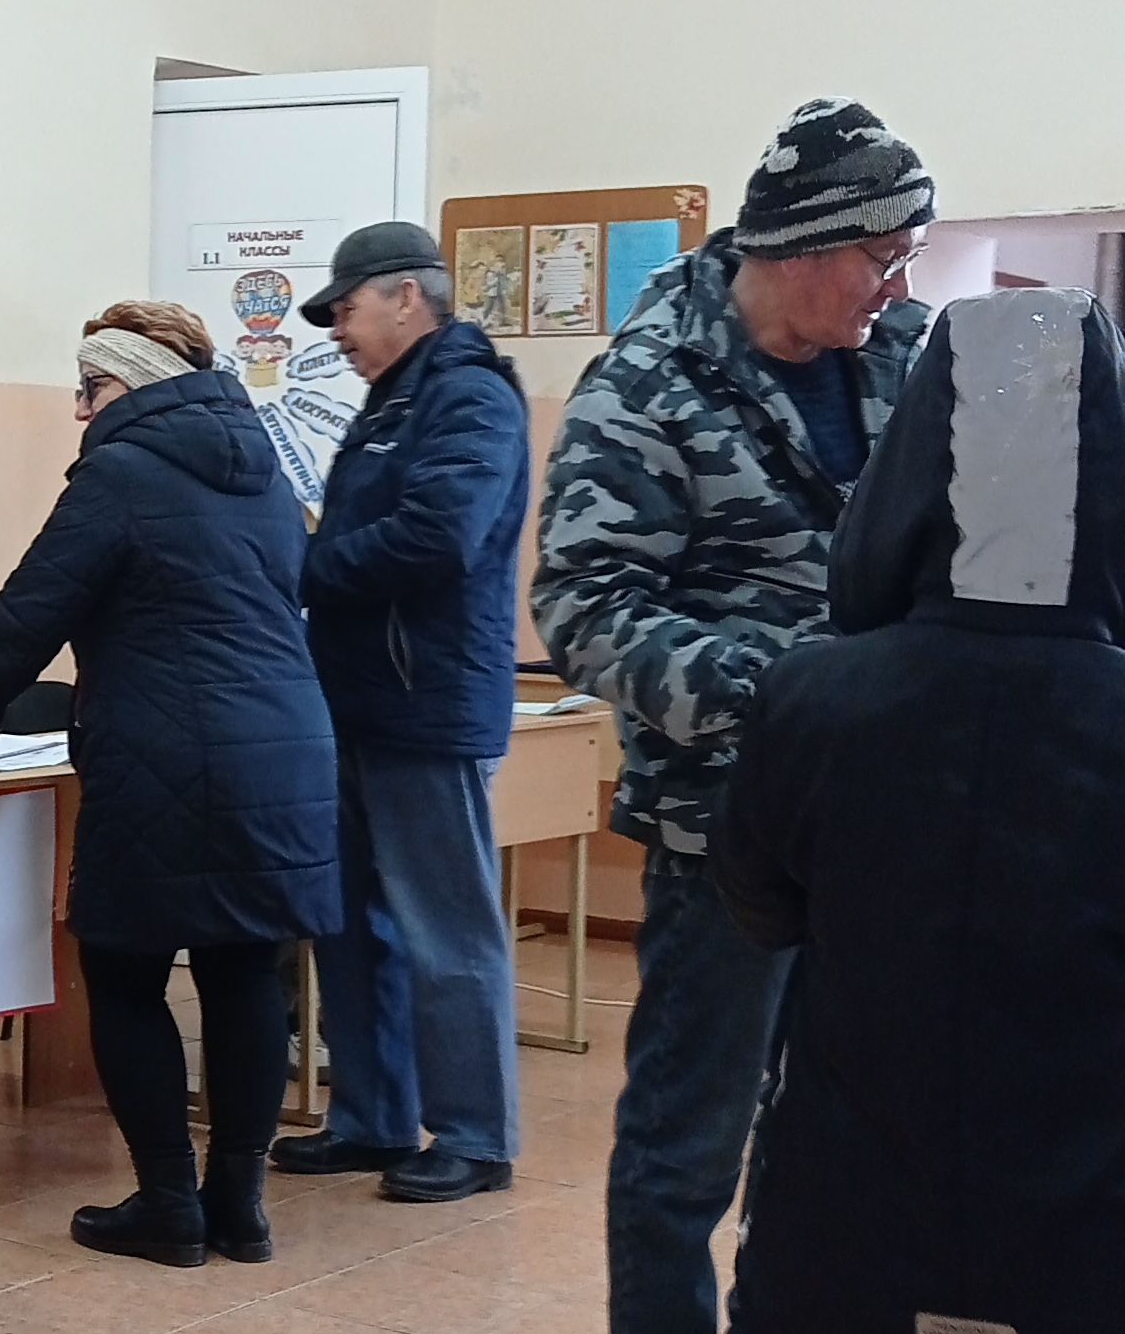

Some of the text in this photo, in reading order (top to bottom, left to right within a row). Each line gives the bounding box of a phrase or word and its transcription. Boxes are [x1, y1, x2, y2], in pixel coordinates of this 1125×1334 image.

[227, 229, 305, 243] НАЧАЛЬНЫЕ
[239, 245, 291, 258] КЛАССЫ
[235, 295, 291, 317] УЧАТСЯ
